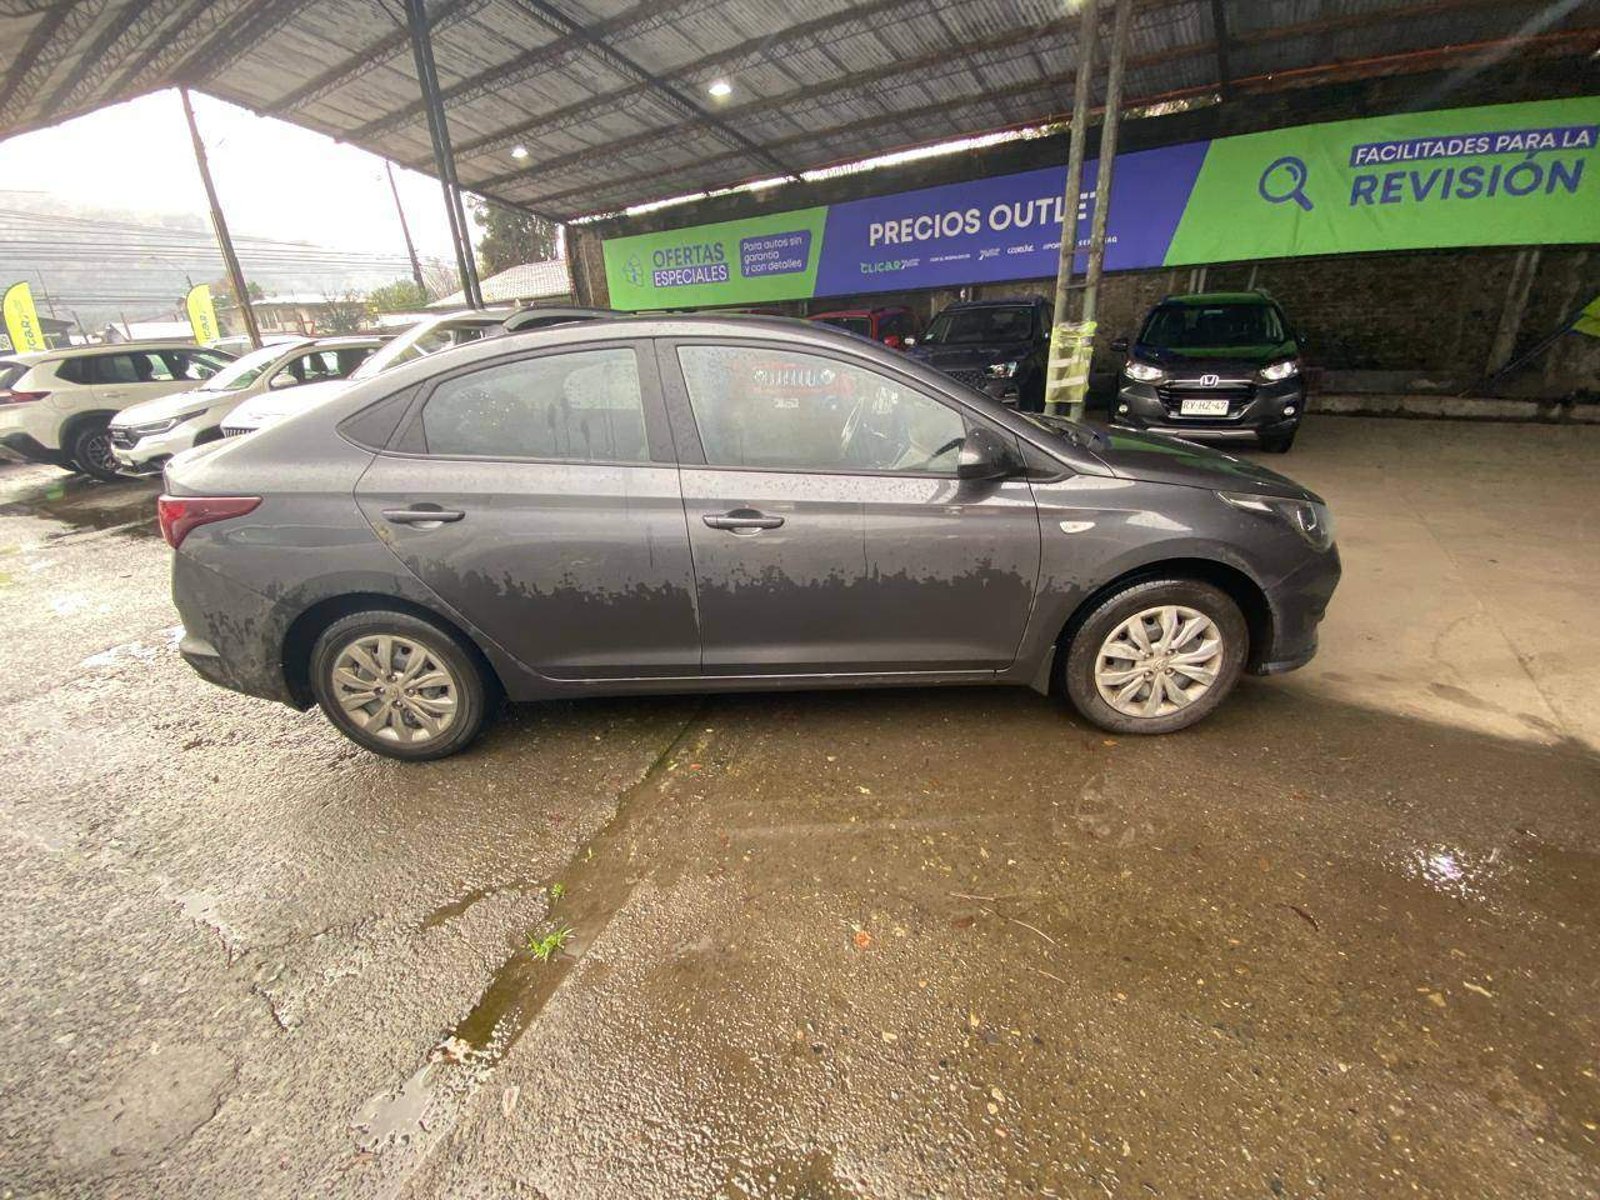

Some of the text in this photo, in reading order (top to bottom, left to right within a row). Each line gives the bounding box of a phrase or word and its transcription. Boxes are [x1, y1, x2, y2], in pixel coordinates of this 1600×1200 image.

[1355, 130, 1590, 164] FACILITADES PARA LA
[1349, 151, 1586, 206] REVISIÓN
[869, 191, 1096, 247] PRECIOS OUTLE
[653, 242, 724, 268] OFERTAS
[743, 236, 802, 251] Para autos sin
[654, 264, 727, 287] ESPECIALES
[751, 263, 767, 272] con
[768, 259, 802, 271] detalles
